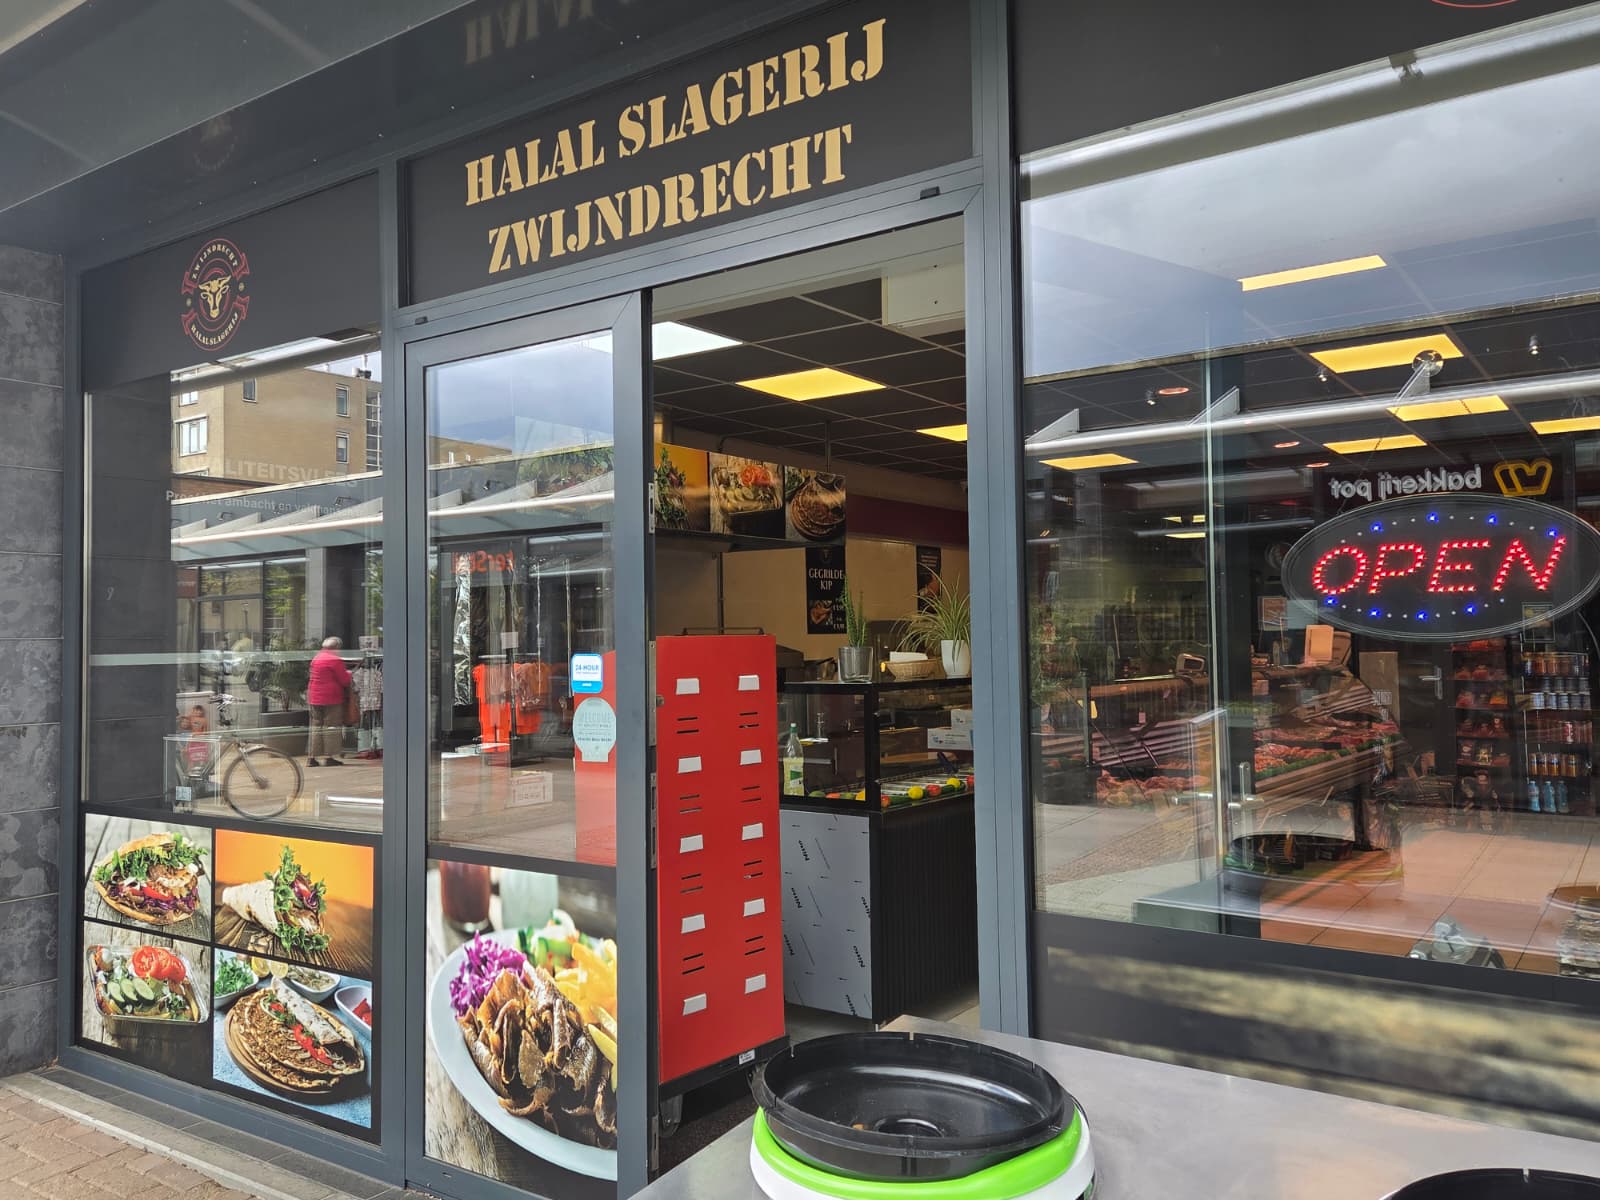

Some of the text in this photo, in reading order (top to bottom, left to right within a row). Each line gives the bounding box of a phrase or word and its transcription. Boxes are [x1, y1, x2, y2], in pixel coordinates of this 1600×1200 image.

[465, 18, 886, 206] HALAL SLAGERIJ
[488, 124, 852, 274] ZWIJNDRECHT
[192, 243, 239, 280] ZWIJNDRECHT
[225, 497, 276, 511] ambacht
[808, 567, 844, 580] GEGRILDE
[1311, 535, 1567, 595] OPEN
[820, 579, 833, 591] KIP
